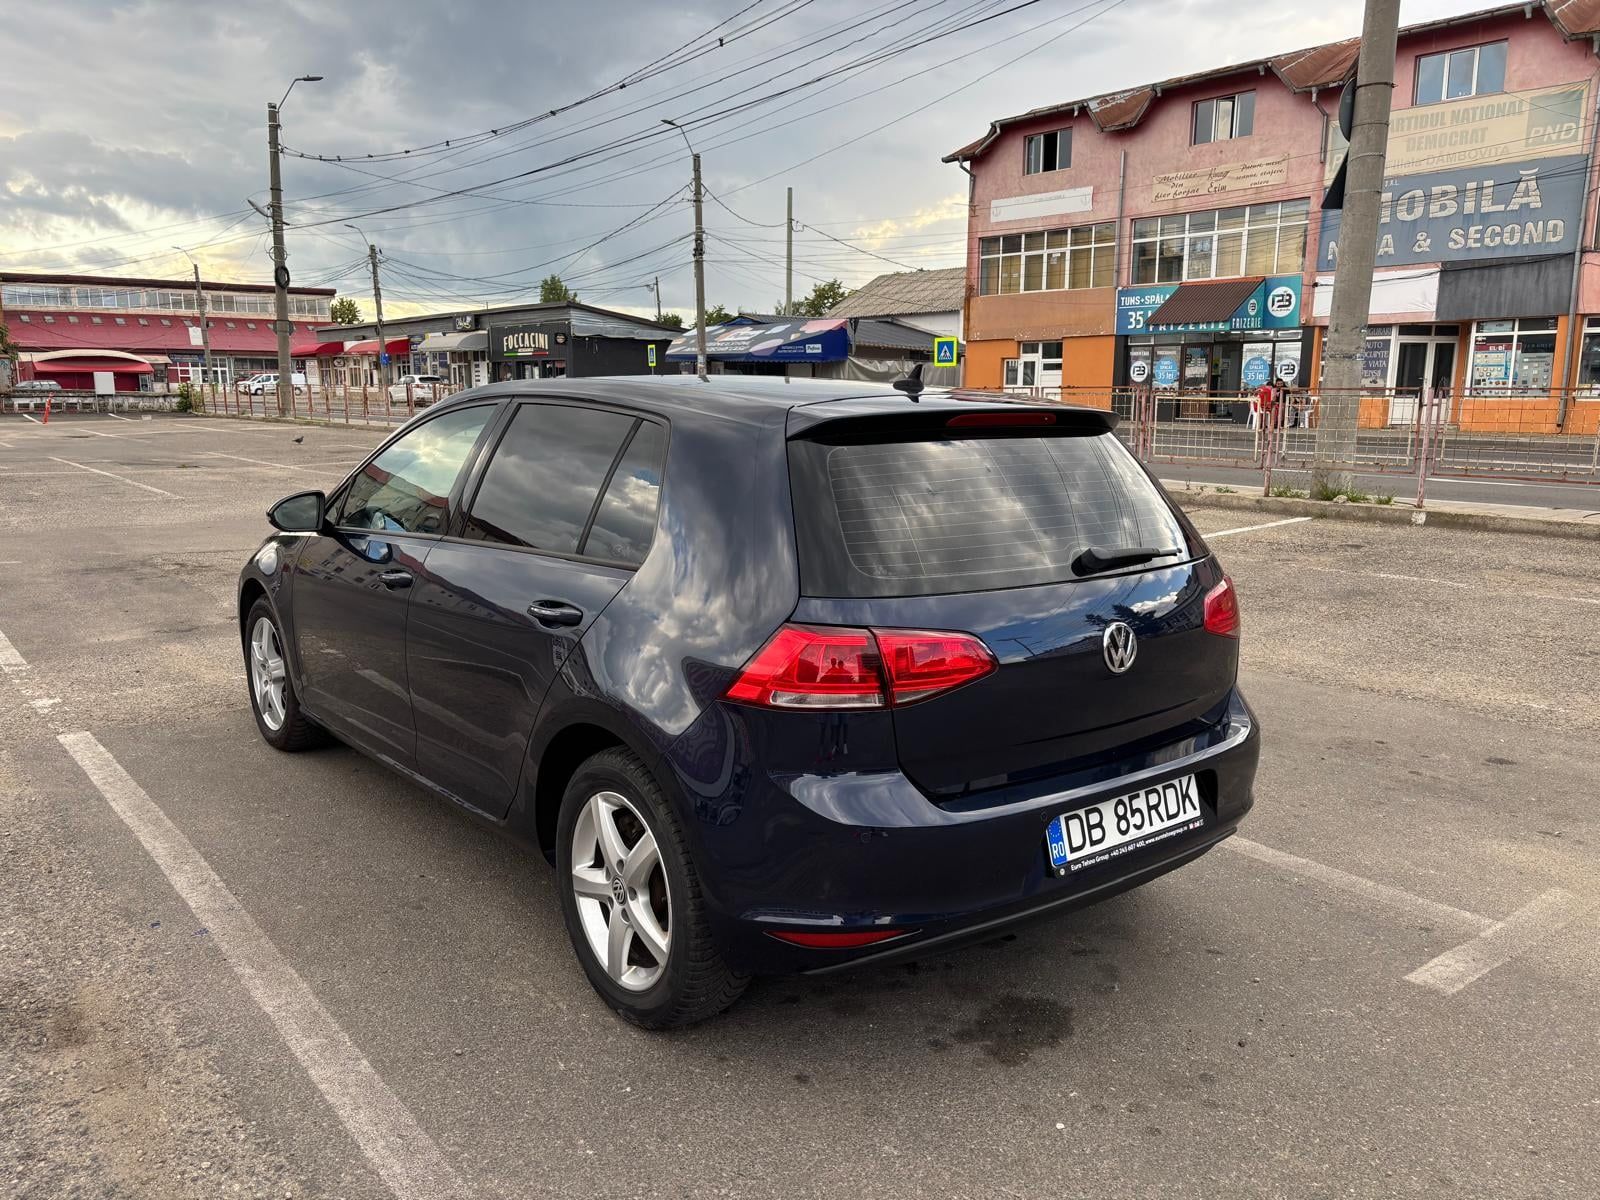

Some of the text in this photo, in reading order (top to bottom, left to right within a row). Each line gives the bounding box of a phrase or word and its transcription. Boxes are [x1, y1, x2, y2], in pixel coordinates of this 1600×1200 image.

[1390, 112, 1446, 134] ARTIDUL
[1528, 122, 1576, 144] PND
[1406, 127, 1488, 152] DEMOCRAT
[1327, 219, 1565, 262] NA & SECOND
[1127, 311, 1144, 329] 35
[1231, 317, 1262, 329] FRIZERIE
[503, 333, 549, 352] FOCCACINI
[1064, 806, 1106, 855] DB
[1051, 841, 1066, 859] RO
[1070, 863, 1082, 872] Euro
